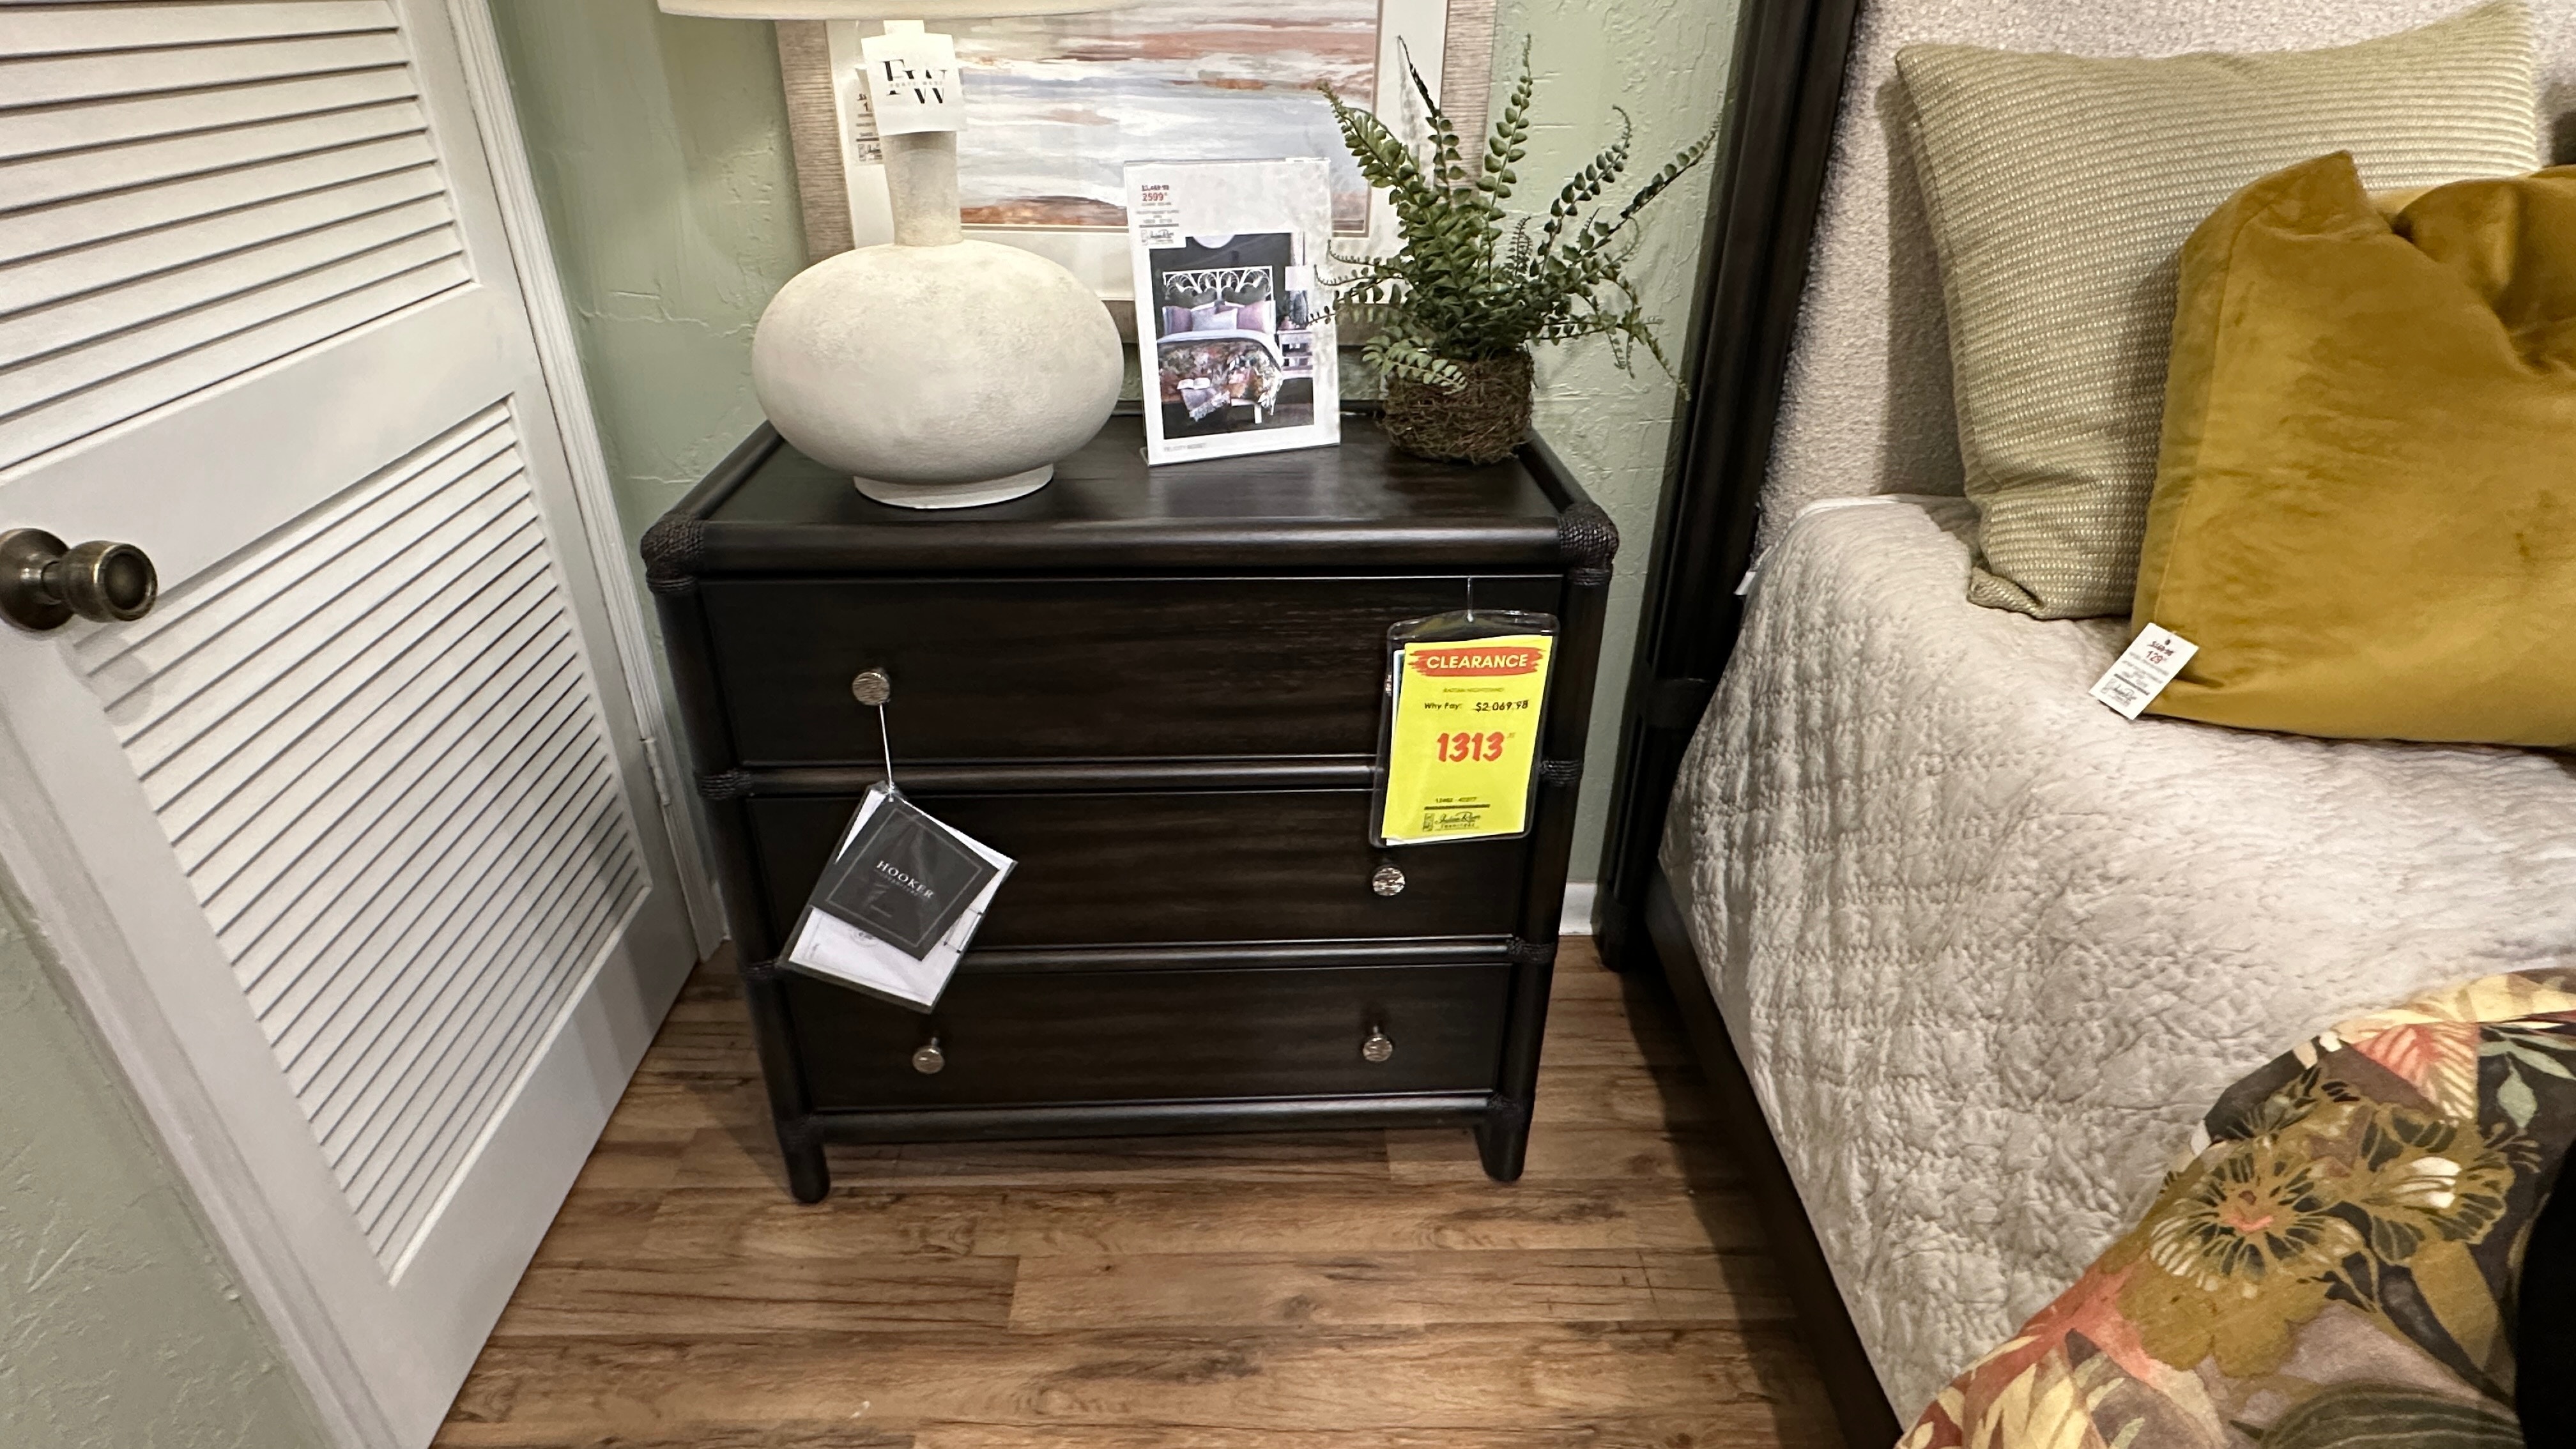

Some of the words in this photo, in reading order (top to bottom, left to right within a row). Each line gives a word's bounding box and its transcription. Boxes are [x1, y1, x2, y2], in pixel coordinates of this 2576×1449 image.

[1426, 654, 1528, 670] CLEARANCE
[1437, 732, 1505, 762] 1313
[877, 860, 934, 898] HOOKER
